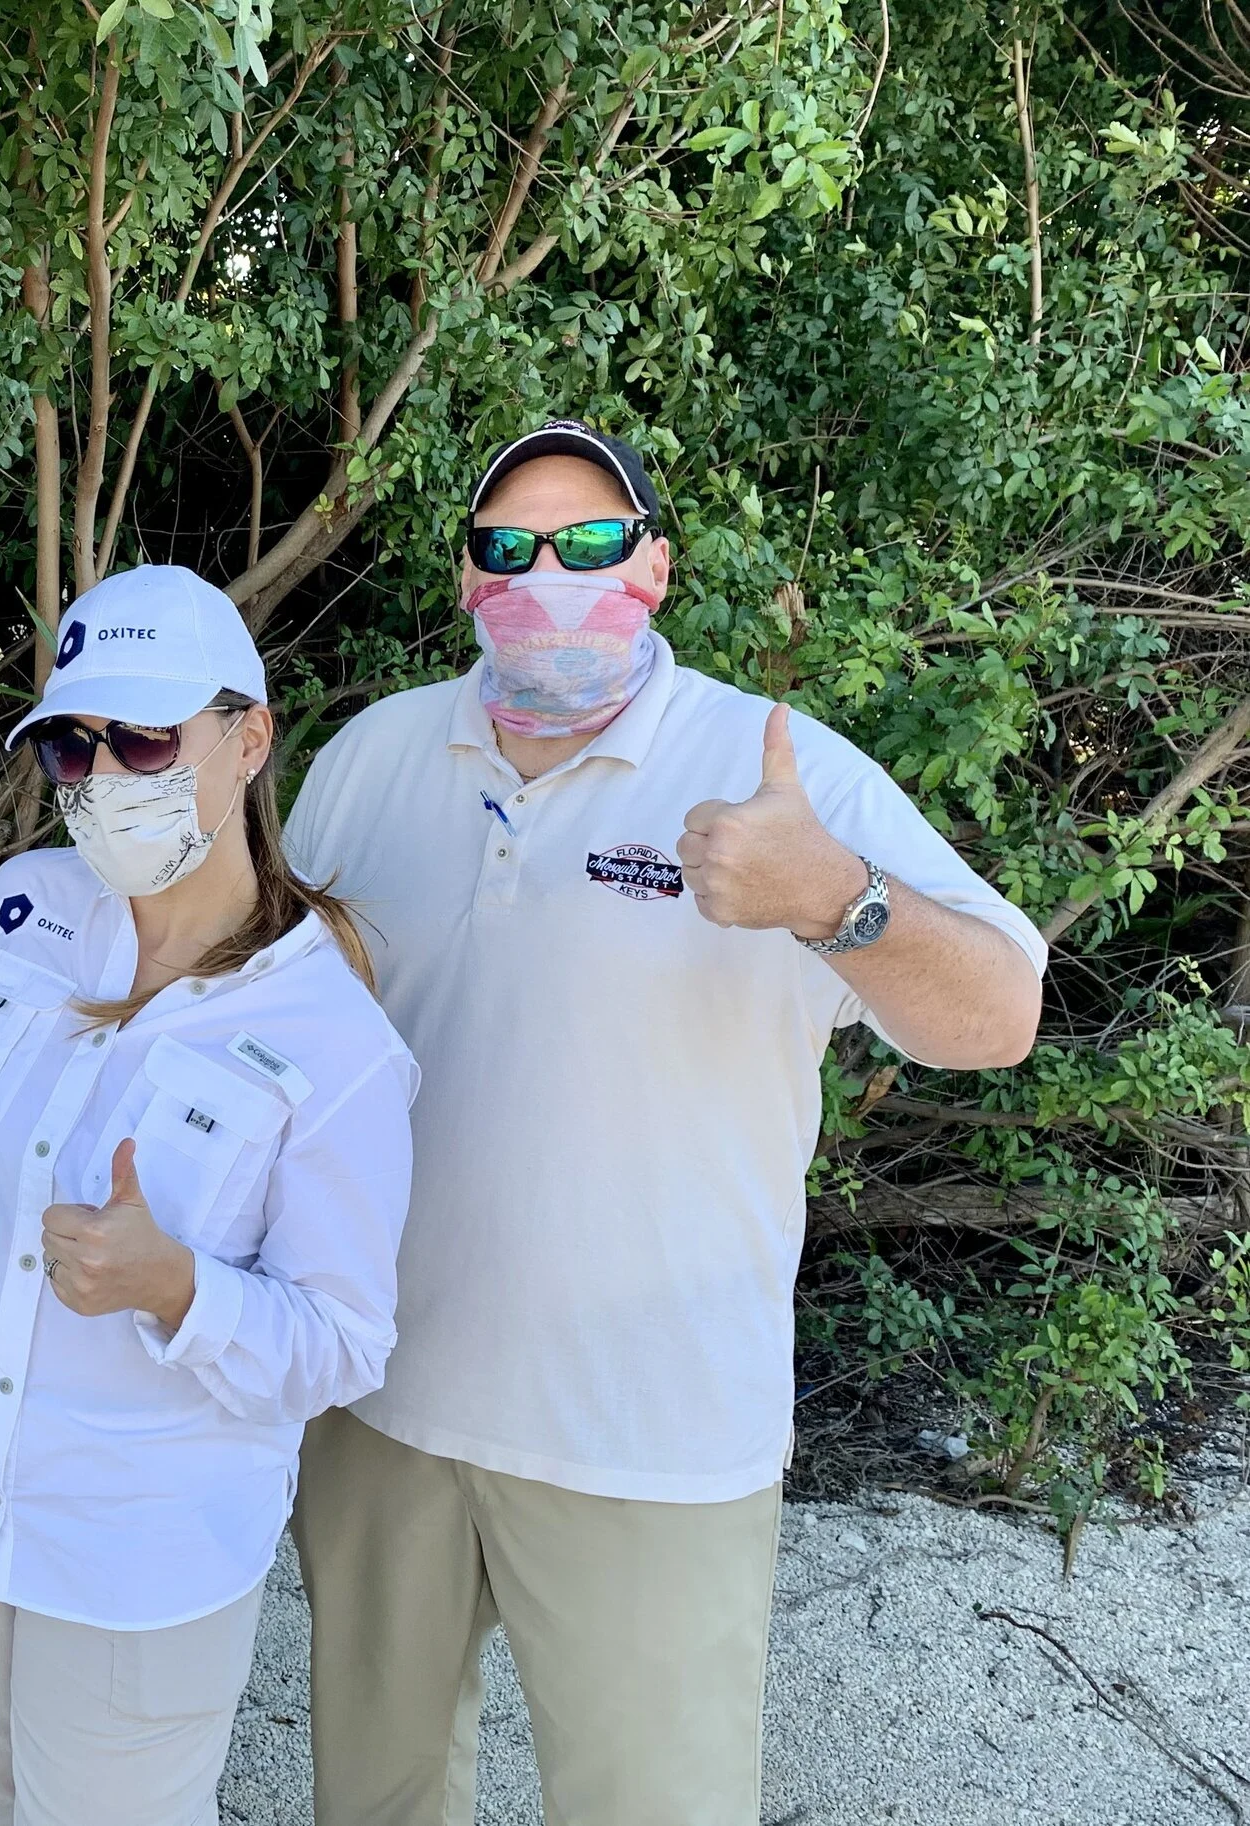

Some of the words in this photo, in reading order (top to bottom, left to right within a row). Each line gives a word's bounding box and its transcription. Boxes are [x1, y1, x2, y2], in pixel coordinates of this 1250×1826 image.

[97, 626, 157, 641] OXITEC
[616, 847, 659, 863] FLORIDA
[151, 859, 177, 887] WEST
[588, 855, 640, 876] Mosquito
[639, 863, 682, 884] Control
[601, 870, 669, 889] DISTRICT
[619, 884, 649, 899] KEYS
[36, 918, 75, 941] OXITEC
